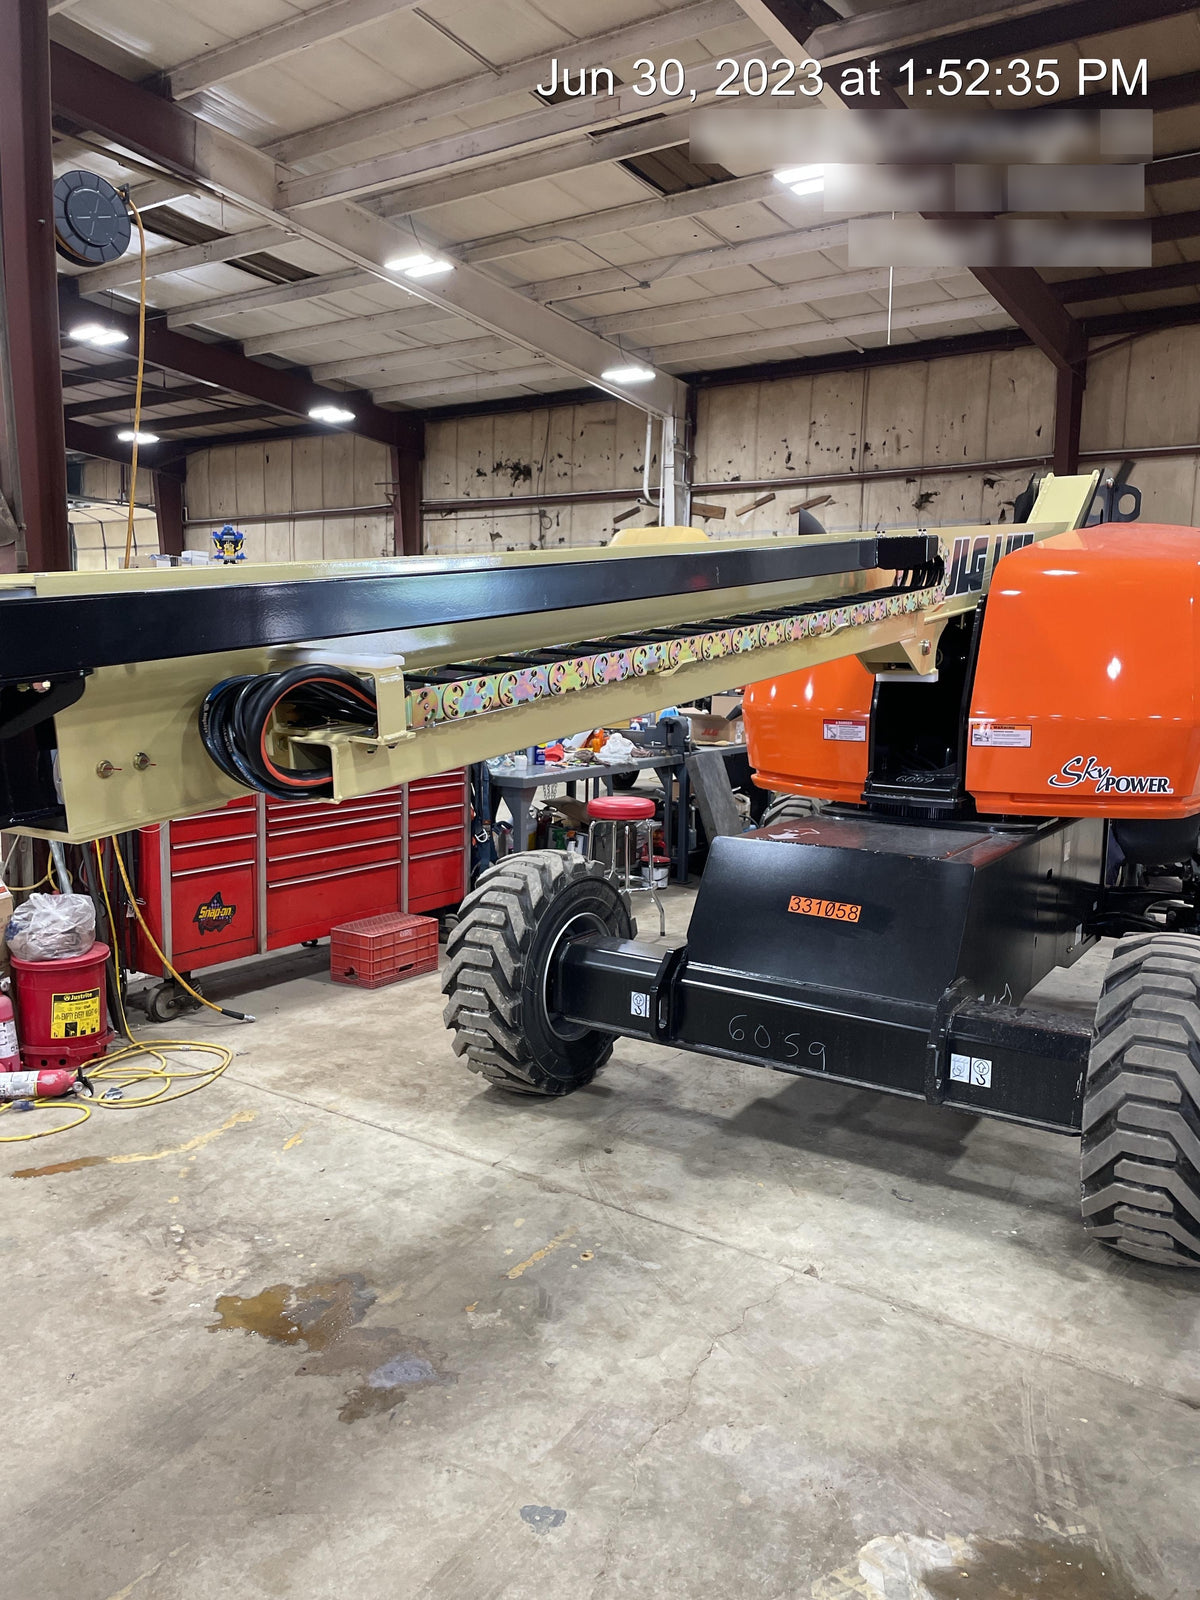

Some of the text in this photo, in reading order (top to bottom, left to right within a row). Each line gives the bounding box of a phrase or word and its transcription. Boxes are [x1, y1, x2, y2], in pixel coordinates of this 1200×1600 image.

[945, 536, 989, 599] JLG
[1048, 756, 1171, 793] Sky POWER
[198, 906, 232, 920] Snap-on
[790, 896, 859, 921] 331058
